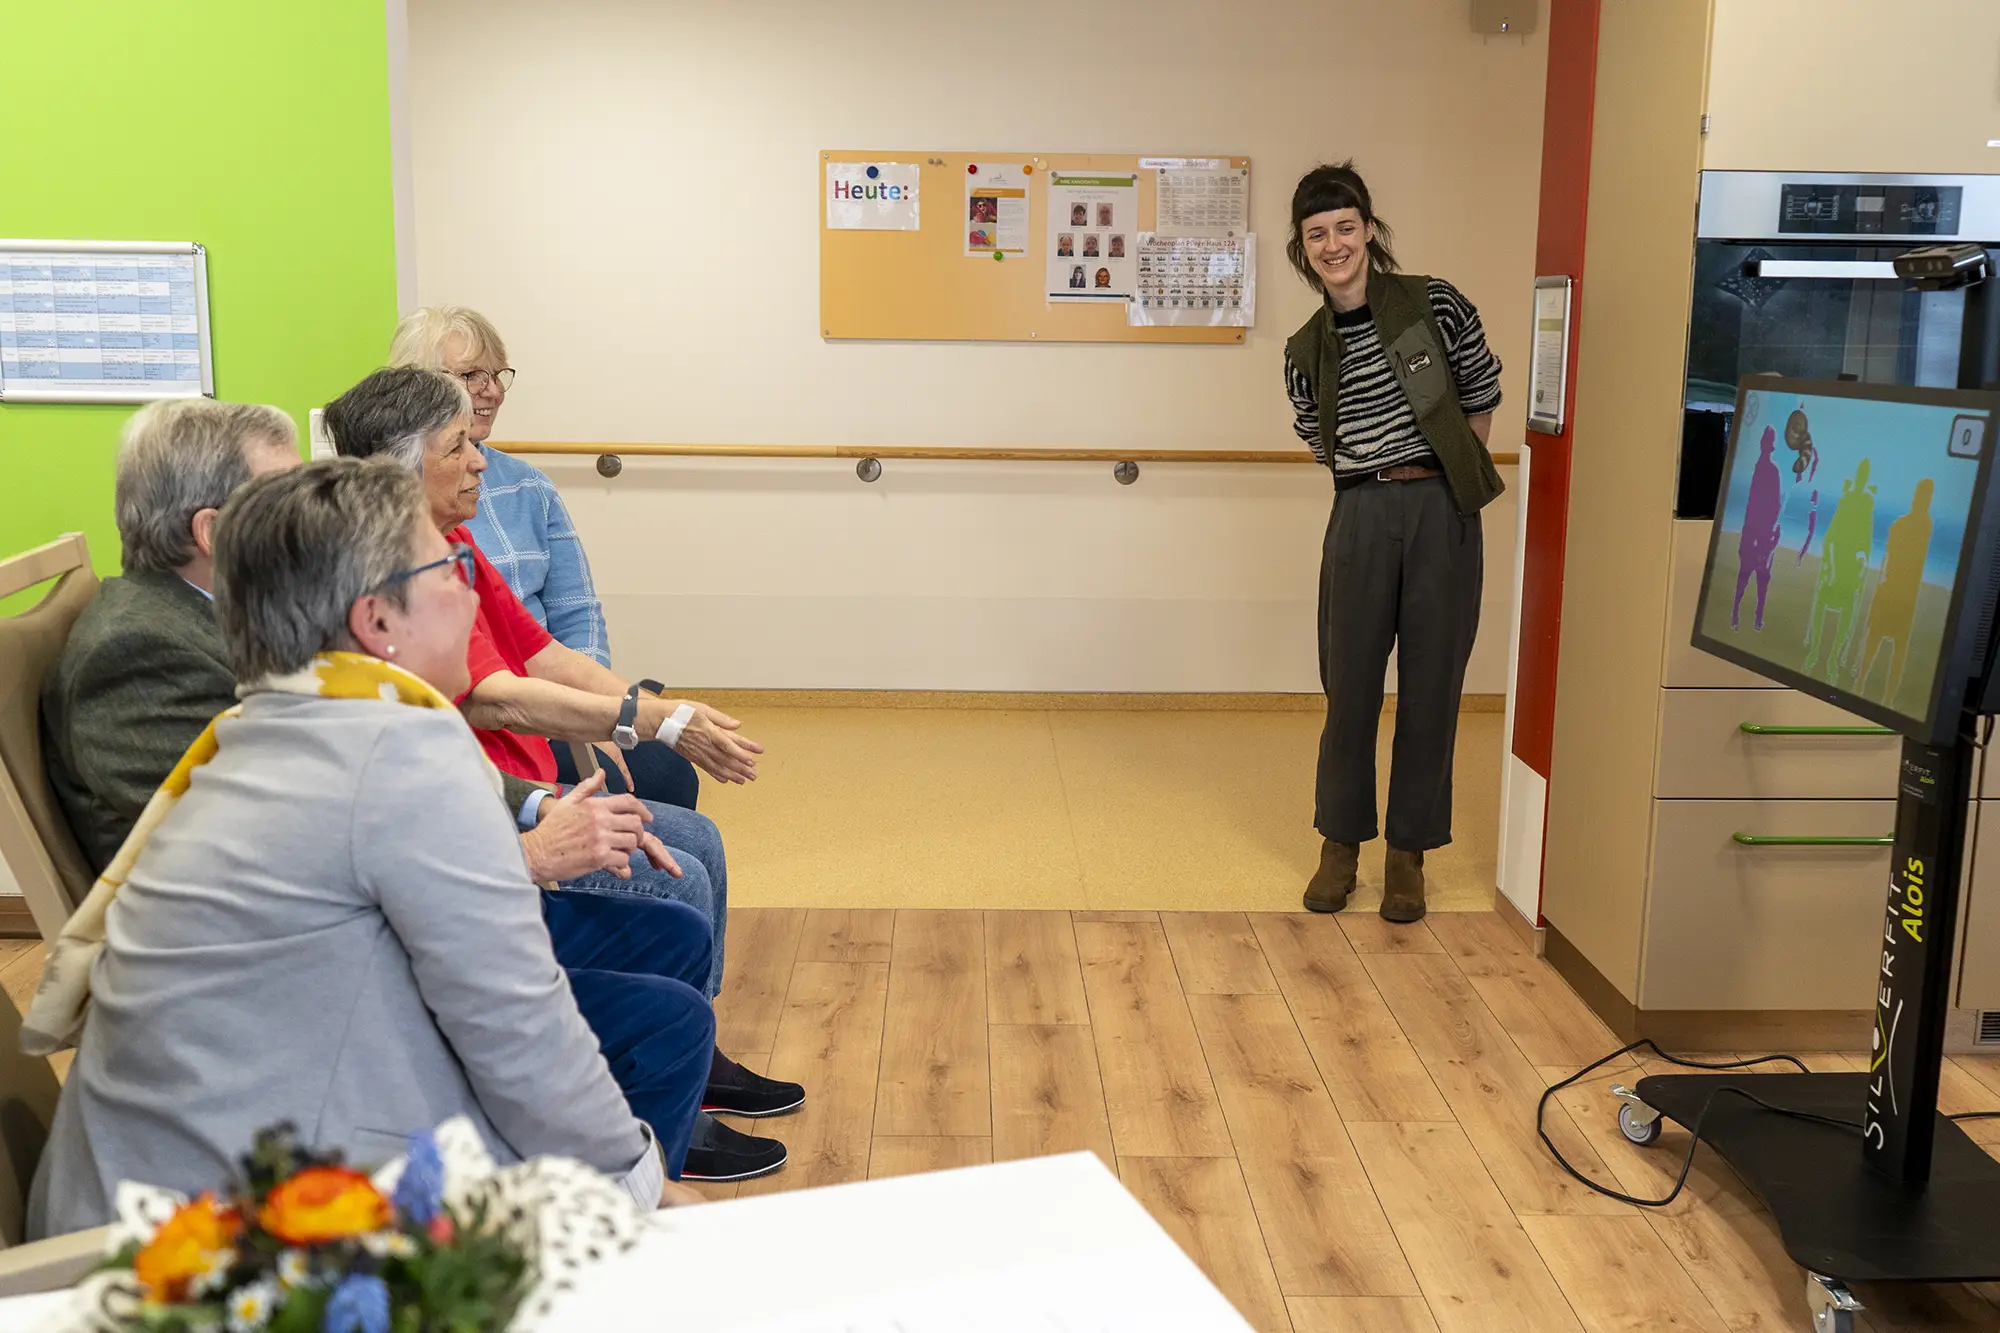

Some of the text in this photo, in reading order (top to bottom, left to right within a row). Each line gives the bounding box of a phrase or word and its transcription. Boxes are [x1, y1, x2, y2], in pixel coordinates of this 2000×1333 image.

[834, 180, 909, 200] Heute:
[1962, 428, 1972, 447] 0
[1901, 857, 1924, 943] Alois
